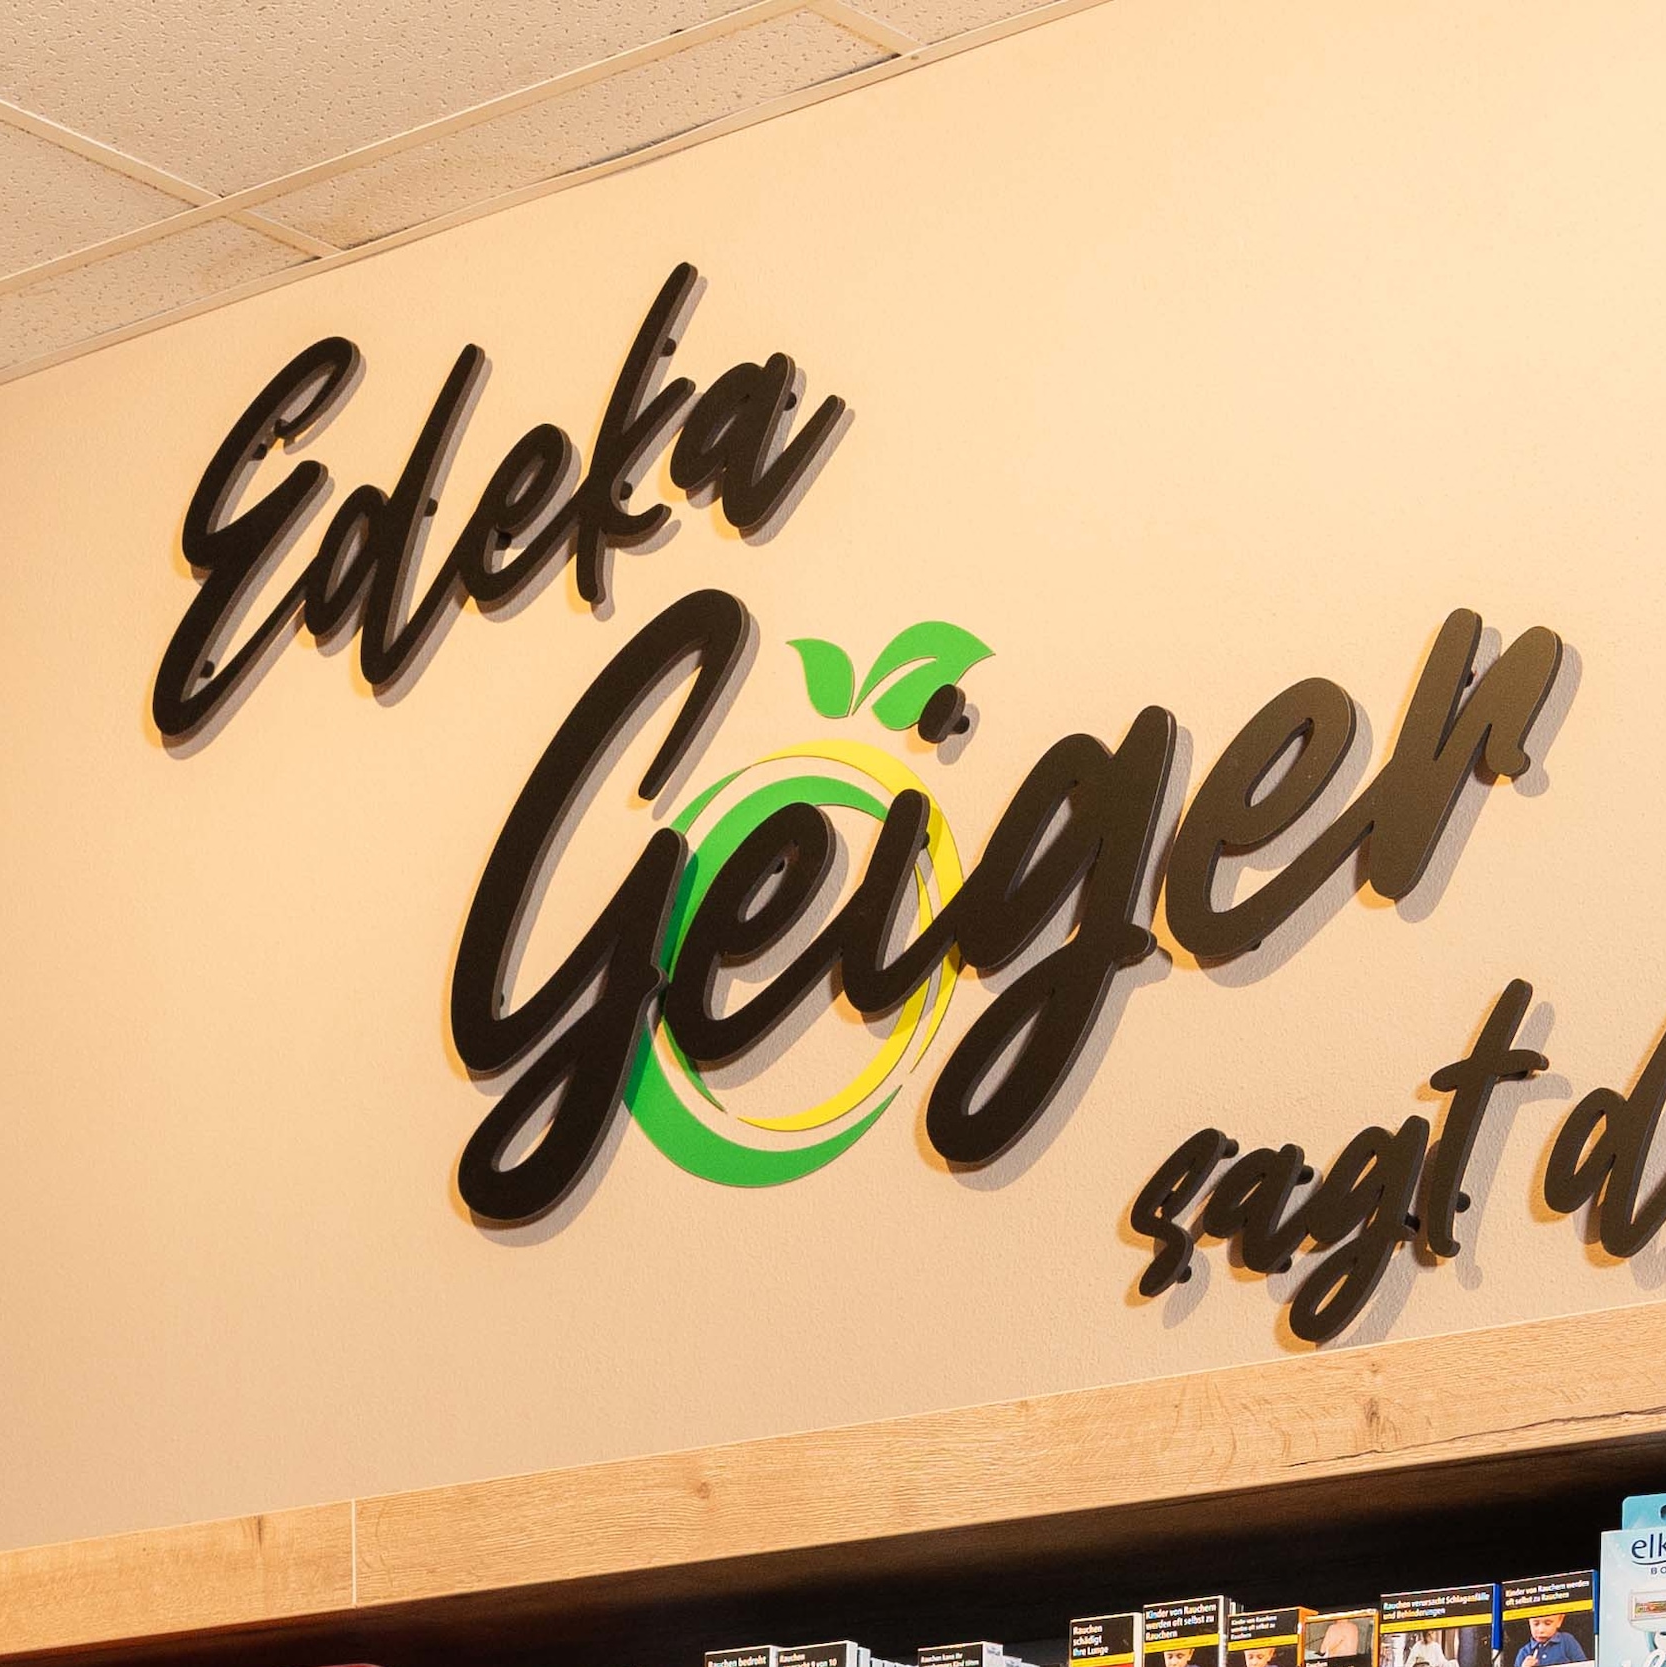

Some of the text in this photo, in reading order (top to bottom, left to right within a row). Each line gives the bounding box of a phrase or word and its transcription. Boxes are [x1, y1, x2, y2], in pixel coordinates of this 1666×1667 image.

[152, 261, 845, 739] Edeka
[452, 588, 1564, 1228] Geiger
[1129, 978, 1542, 1345] sagt
